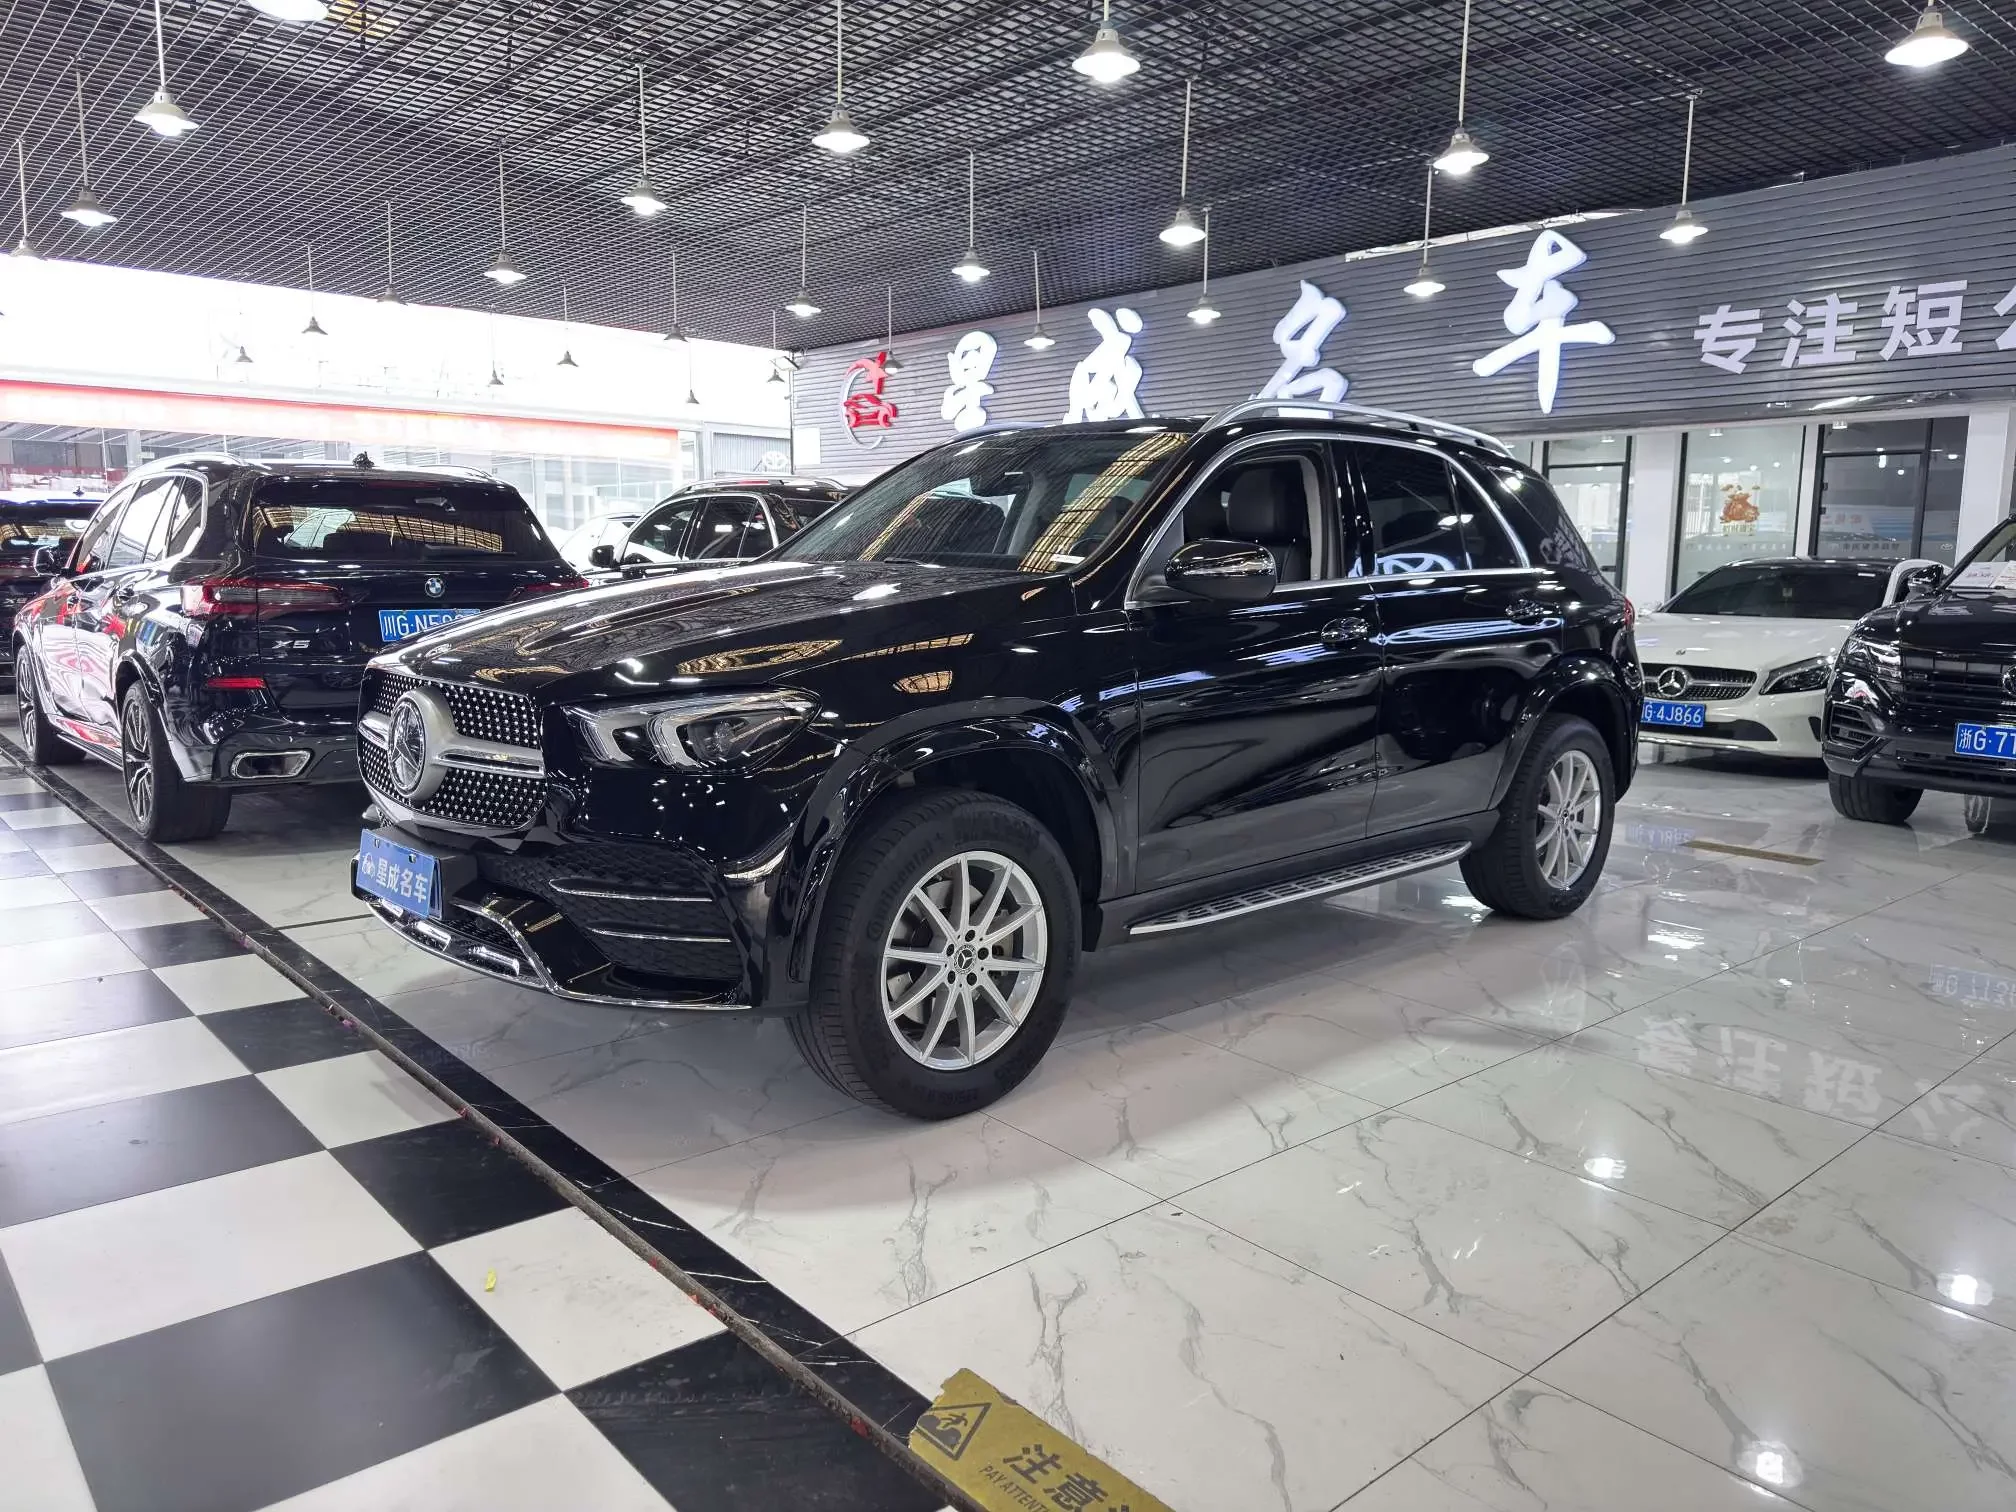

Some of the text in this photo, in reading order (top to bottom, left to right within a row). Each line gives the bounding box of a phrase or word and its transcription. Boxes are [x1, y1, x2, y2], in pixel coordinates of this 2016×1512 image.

[1693, 279, 2016, 375] 专注短
[383, 614, 464, 637] 川G·N5
[272, 639, 311, 649] X5
[1642, 704, 1702, 724] G·4J866
[979, 1465, 1007, 1484] PAY
[1003, 1443, 1131, 1512] 注意
